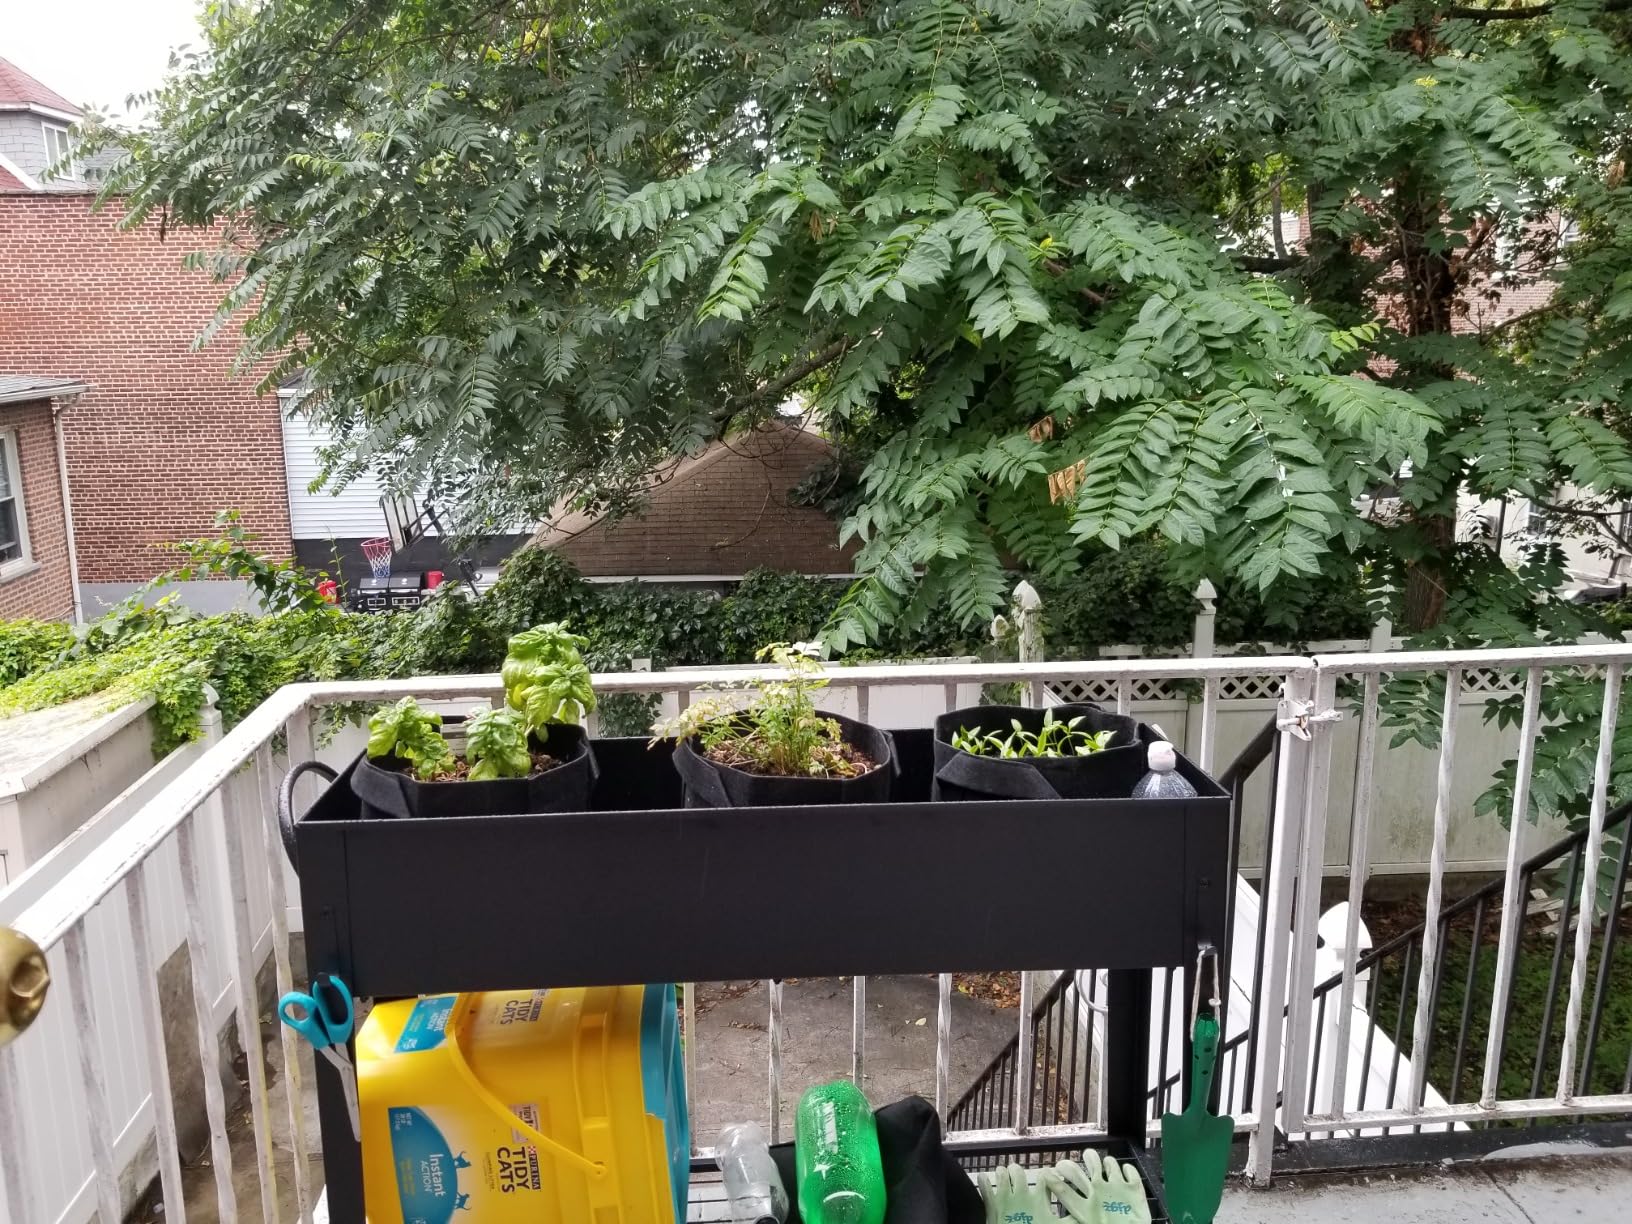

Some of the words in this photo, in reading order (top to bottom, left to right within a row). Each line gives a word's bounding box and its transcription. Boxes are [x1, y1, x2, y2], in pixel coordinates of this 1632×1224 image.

[500, 1000, 518, 1024] CATS
[515, 999, 533, 1021] TIDY
[420, 1160, 432, 1192] ACTION
[429, 1153, 446, 1197] Instant
[497, 1147, 515, 1193] CATS
[512, 1147, 529, 1189] TIDY
[529, 1154, 541, 1190] PURINA
